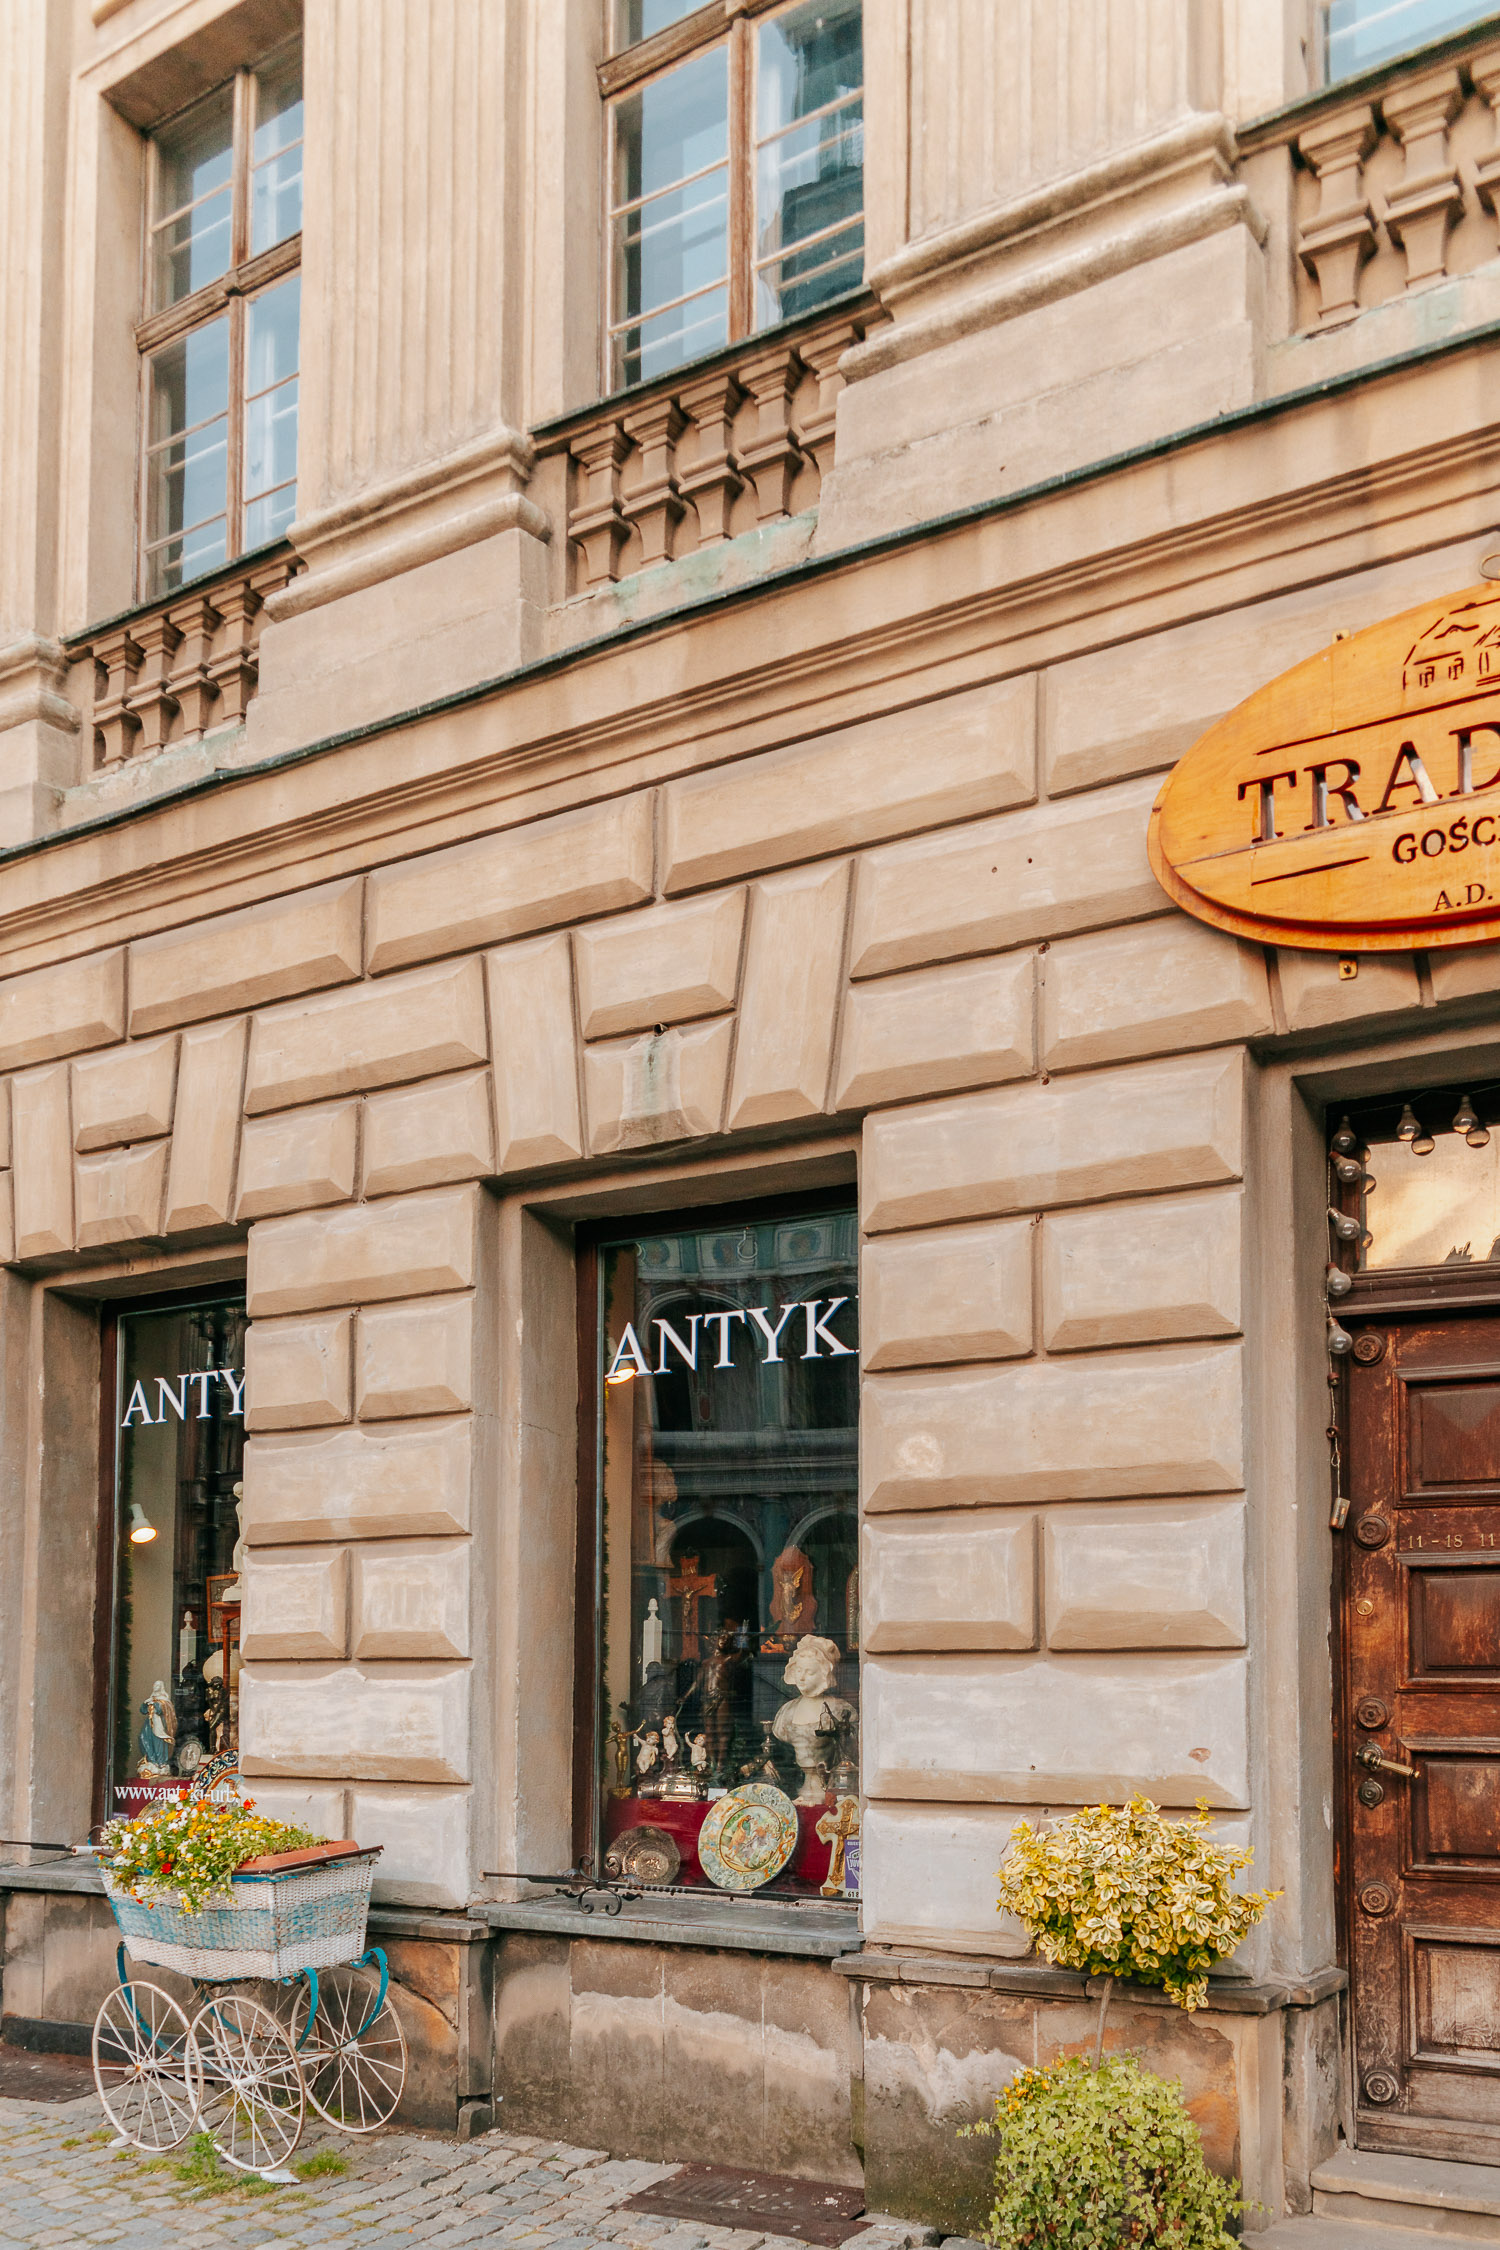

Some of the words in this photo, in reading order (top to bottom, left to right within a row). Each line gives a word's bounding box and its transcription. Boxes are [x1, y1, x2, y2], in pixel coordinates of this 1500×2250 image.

[1238, 720, 1500, 843] TRAD
[1392, 815, 1500, 864] GOŚC
[1433, 882, 1494, 912] A.D.
[604, 1295, 860, 1379] ANTYK
[120, 1367, 246, 1428] ANTY
